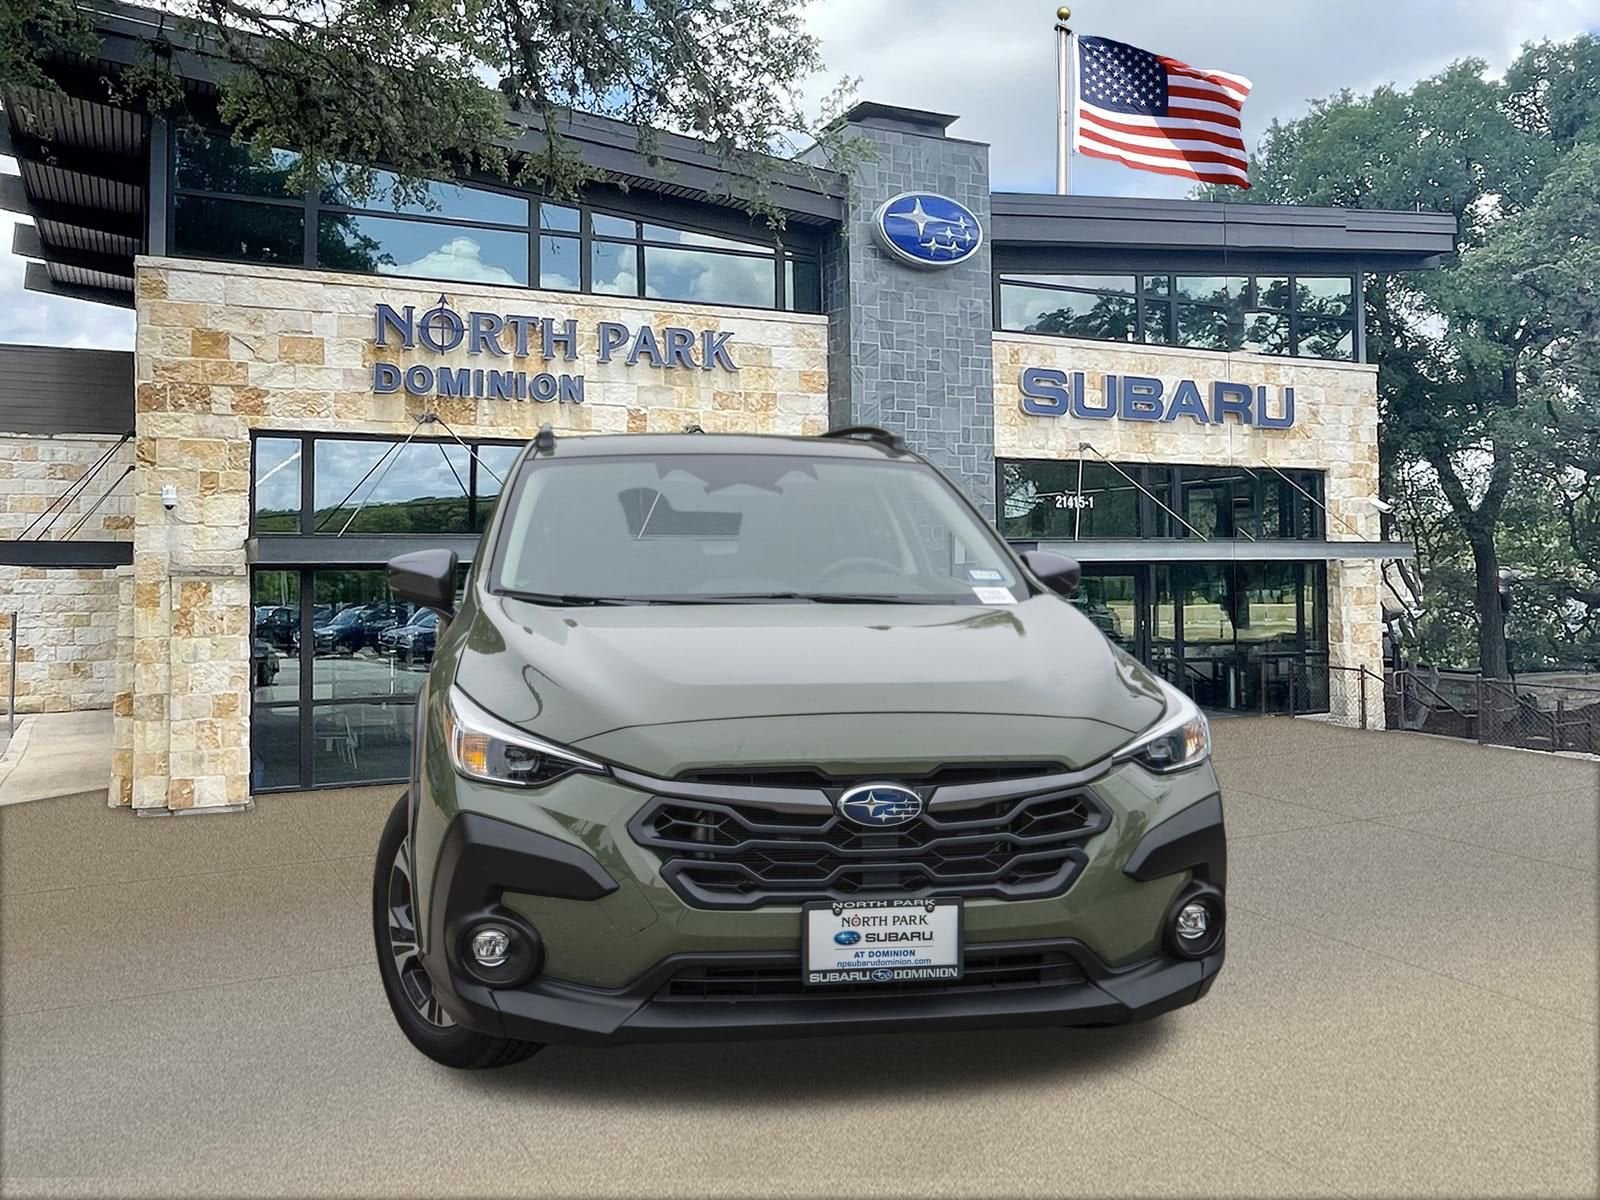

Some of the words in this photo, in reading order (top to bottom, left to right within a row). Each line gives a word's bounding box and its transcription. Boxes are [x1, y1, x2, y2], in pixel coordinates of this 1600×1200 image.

[375, 293, 579, 361] NORTH
[599, 321, 741, 372] PARK
[373, 362, 585, 403] DOMINION
[1019, 367, 1295, 430] SUBARU
[832, 901, 887, 909] NORTH
[841, 914, 888, 927] NORTH
[892, 914, 929, 926] PARK
[865, 931, 933, 943] SUBARU
[854, 951, 865, 959] AT
[868, 950, 916, 958] DOMINION
[836, 959, 931, 969] npsubarudominion.com
[809, 971, 870, 983] SUBARU
[893, 968, 958, 980] DOMINION
